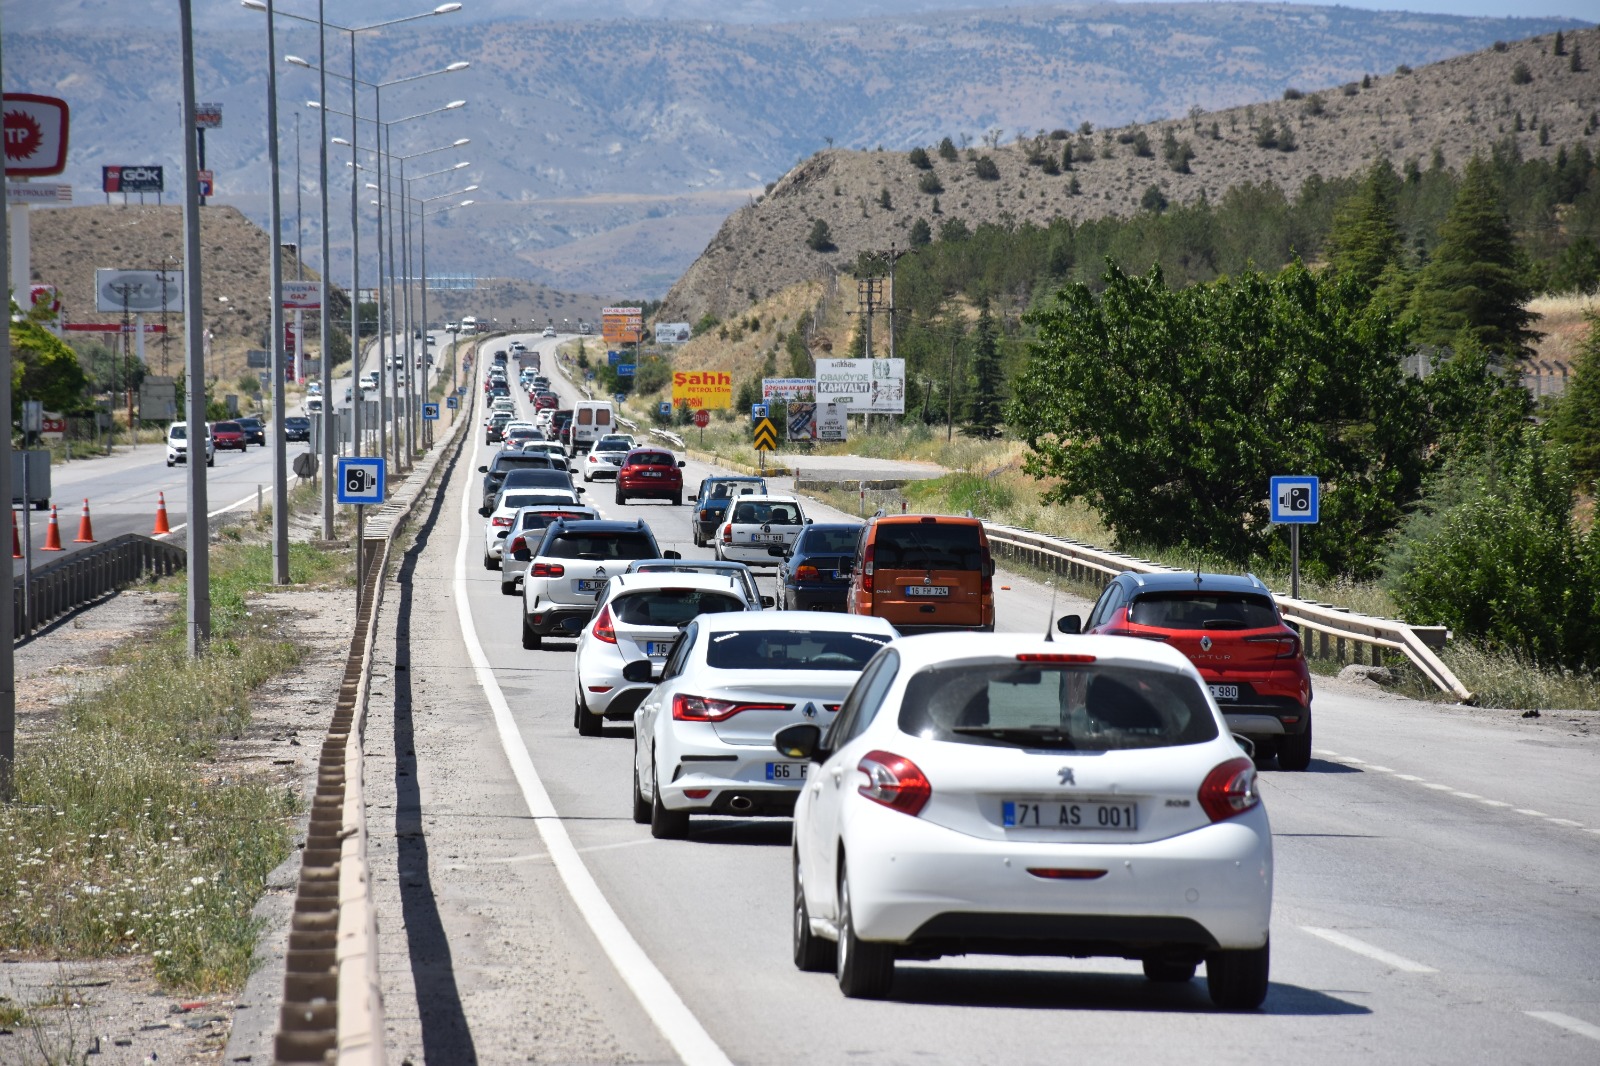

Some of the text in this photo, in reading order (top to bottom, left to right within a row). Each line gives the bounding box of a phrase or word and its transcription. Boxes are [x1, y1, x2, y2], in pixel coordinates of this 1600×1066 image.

[5, 128, 29, 143] TP
[122, 168, 159, 181] GÖK
[820, 372, 869, 381] OBAKÖY'DE
[820, 382, 868, 393] KAHVALTI
[695, 414, 709, 423] DUR
[934, 588, 947, 596] 724
[655, 643, 667, 653] 16
[1218, 686, 1237, 697] 980
[774, 764, 790, 778] 66
[1018, 804, 1040, 825] 71
[1059, 805, 1081, 825] AS
[1098, 806, 1132, 827] 001
